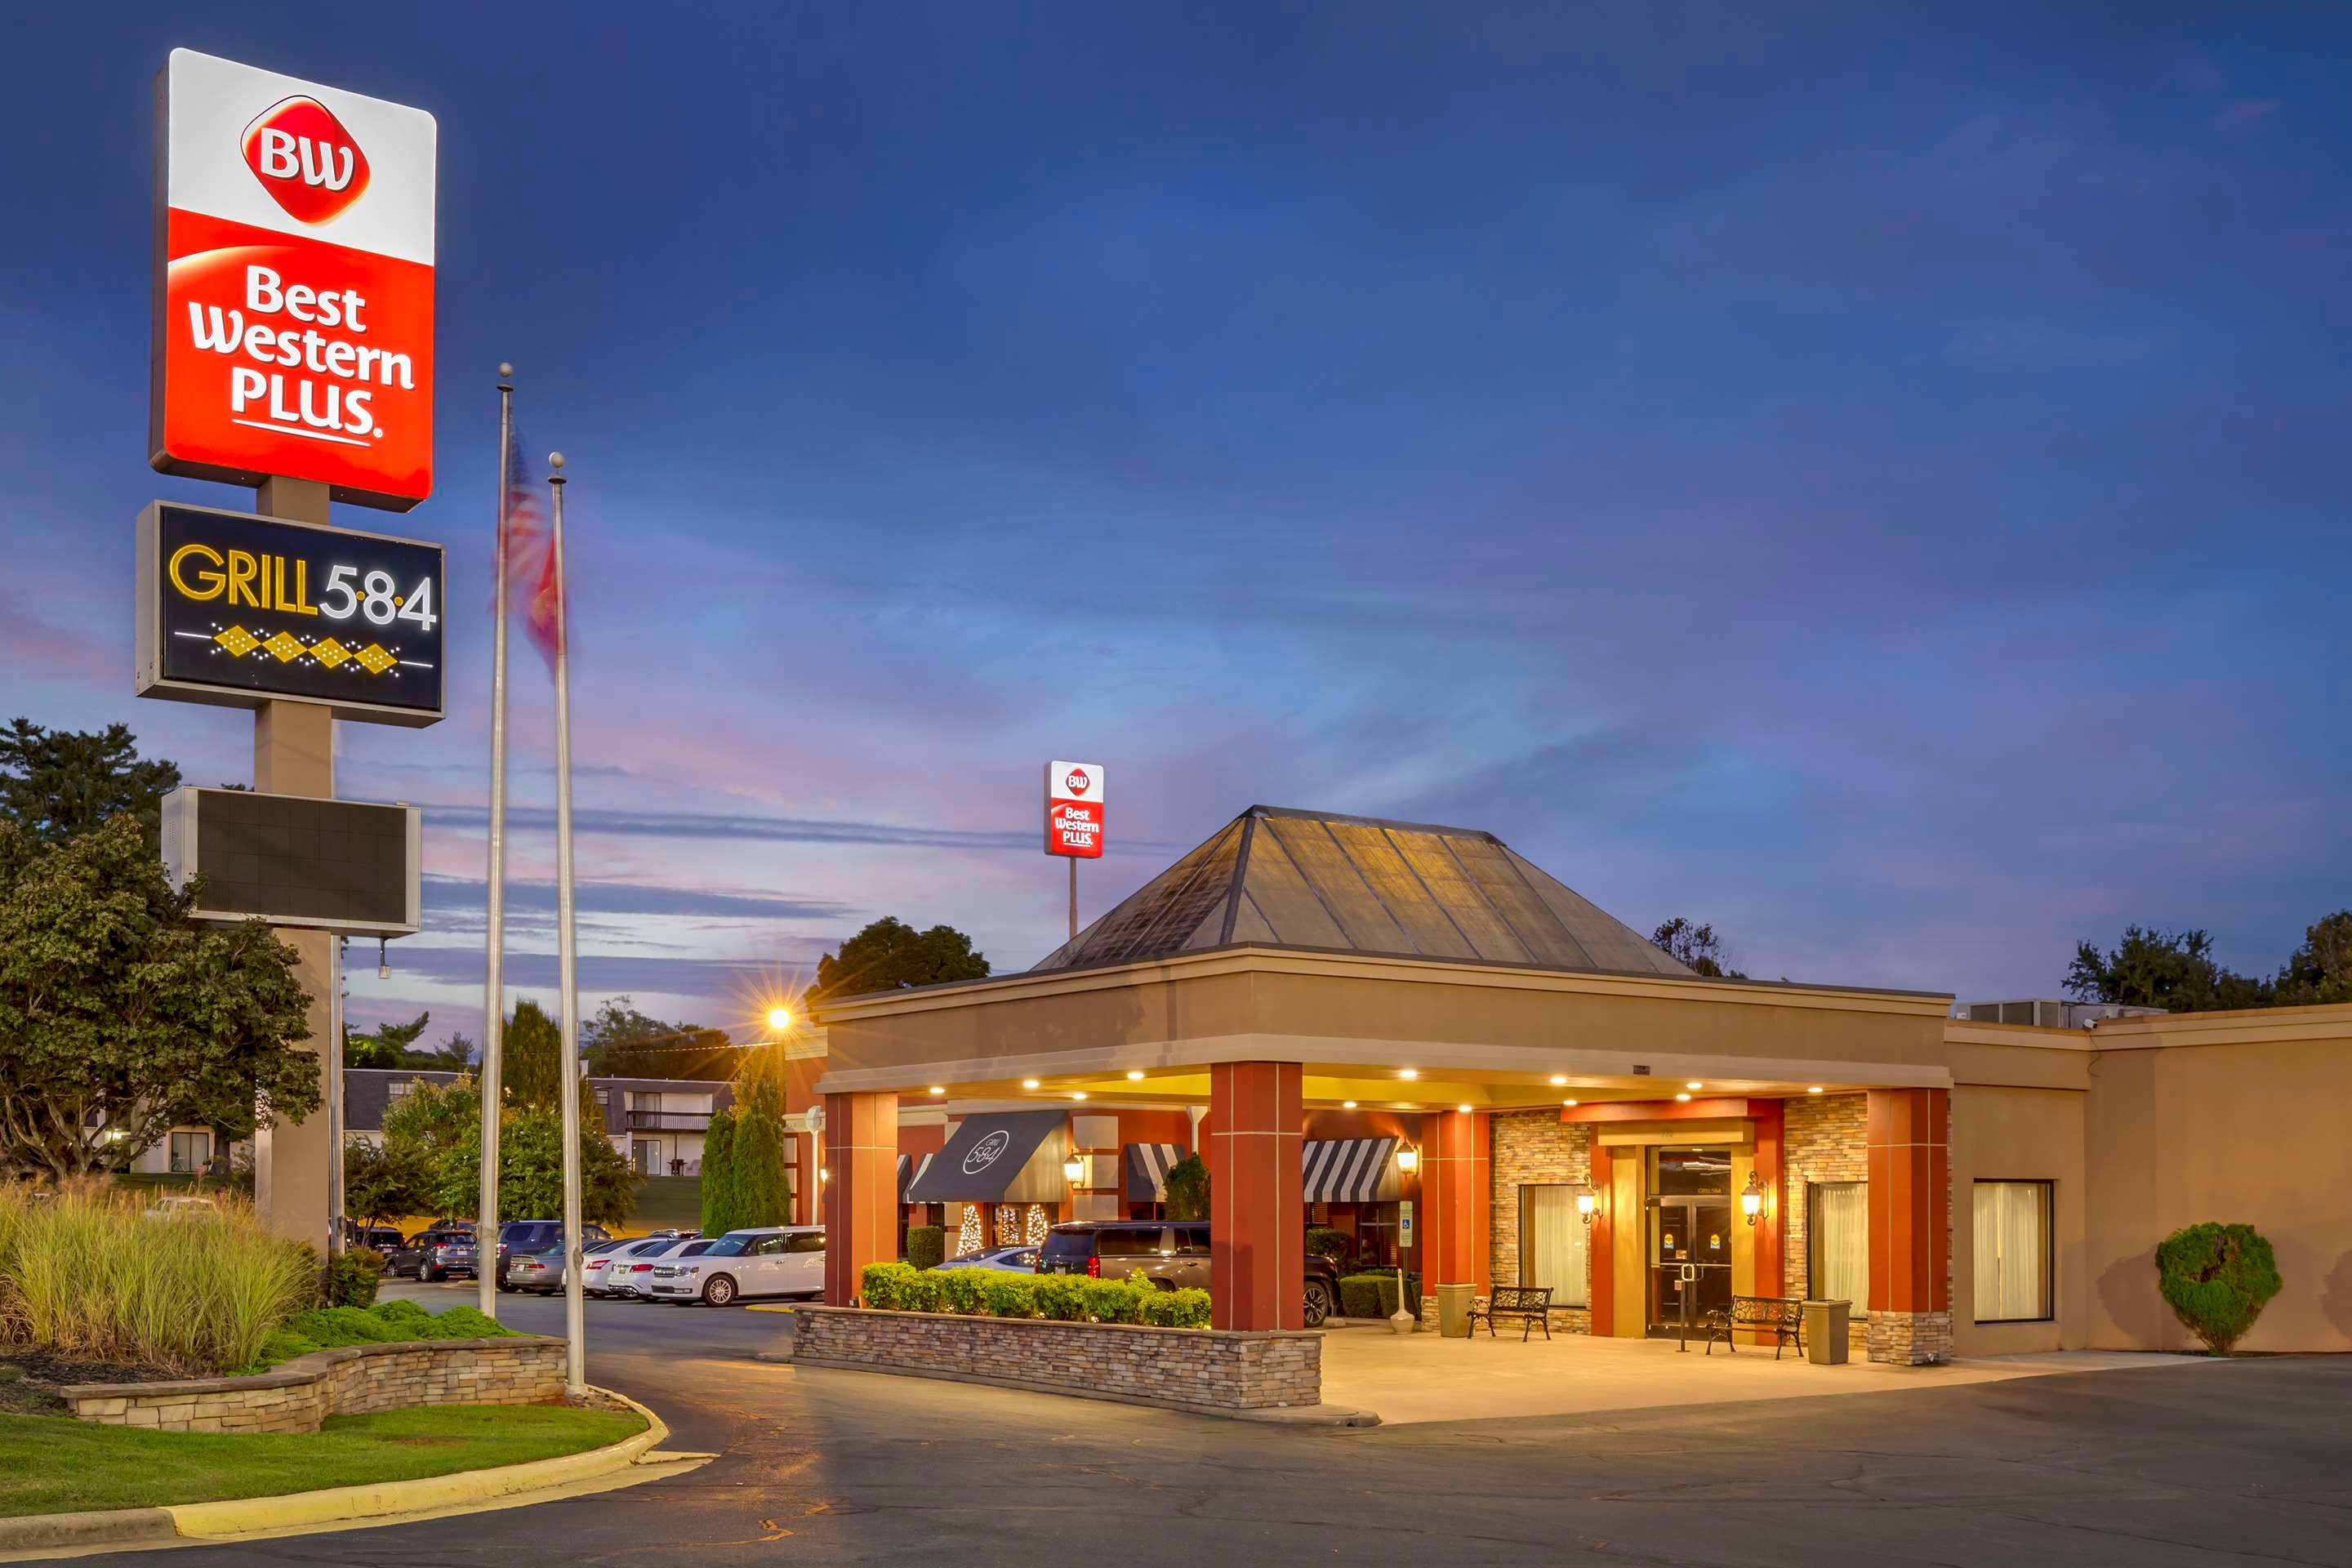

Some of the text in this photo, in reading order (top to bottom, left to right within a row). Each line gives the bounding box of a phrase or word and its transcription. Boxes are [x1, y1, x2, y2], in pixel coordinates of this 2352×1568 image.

[260, 127, 355, 191] BW
[246, 265, 368, 332] Best
[187, 301, 415, 390] Western
[169, 543, 318, 616] GRILL
[1067, 775, 1088, 789] BW
[1054, 817, 1099, 833] Western
[1065, 807, 1090, 822] Best
